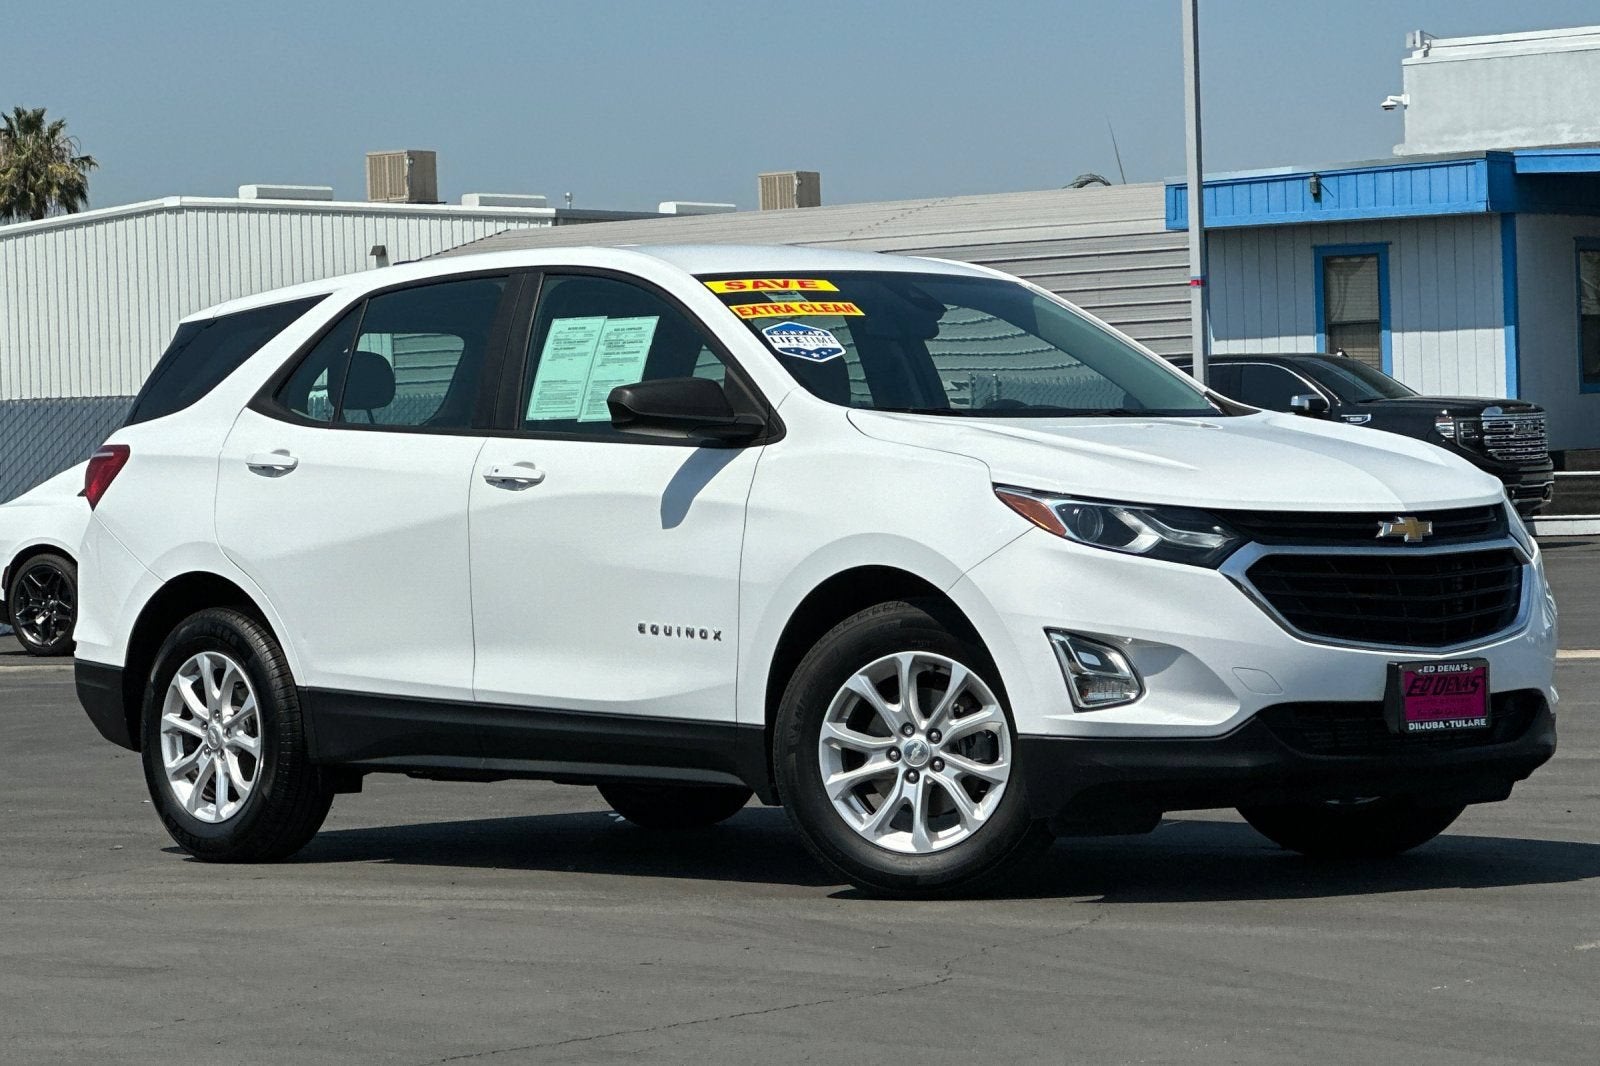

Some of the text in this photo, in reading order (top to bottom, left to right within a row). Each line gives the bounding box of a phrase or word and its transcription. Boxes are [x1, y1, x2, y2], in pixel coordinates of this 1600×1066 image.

[724, 279, 820, 291] SAVE
[735, 302, 857, 317] EXTRA CLEAN
[769, 335, 838, 345] LIFETIME
[637, 622, 722, 641] EQUINOX
[1423, 663, 1469, 673] ED DENA'S
[1449, 718, 1487, 728] TULARE
